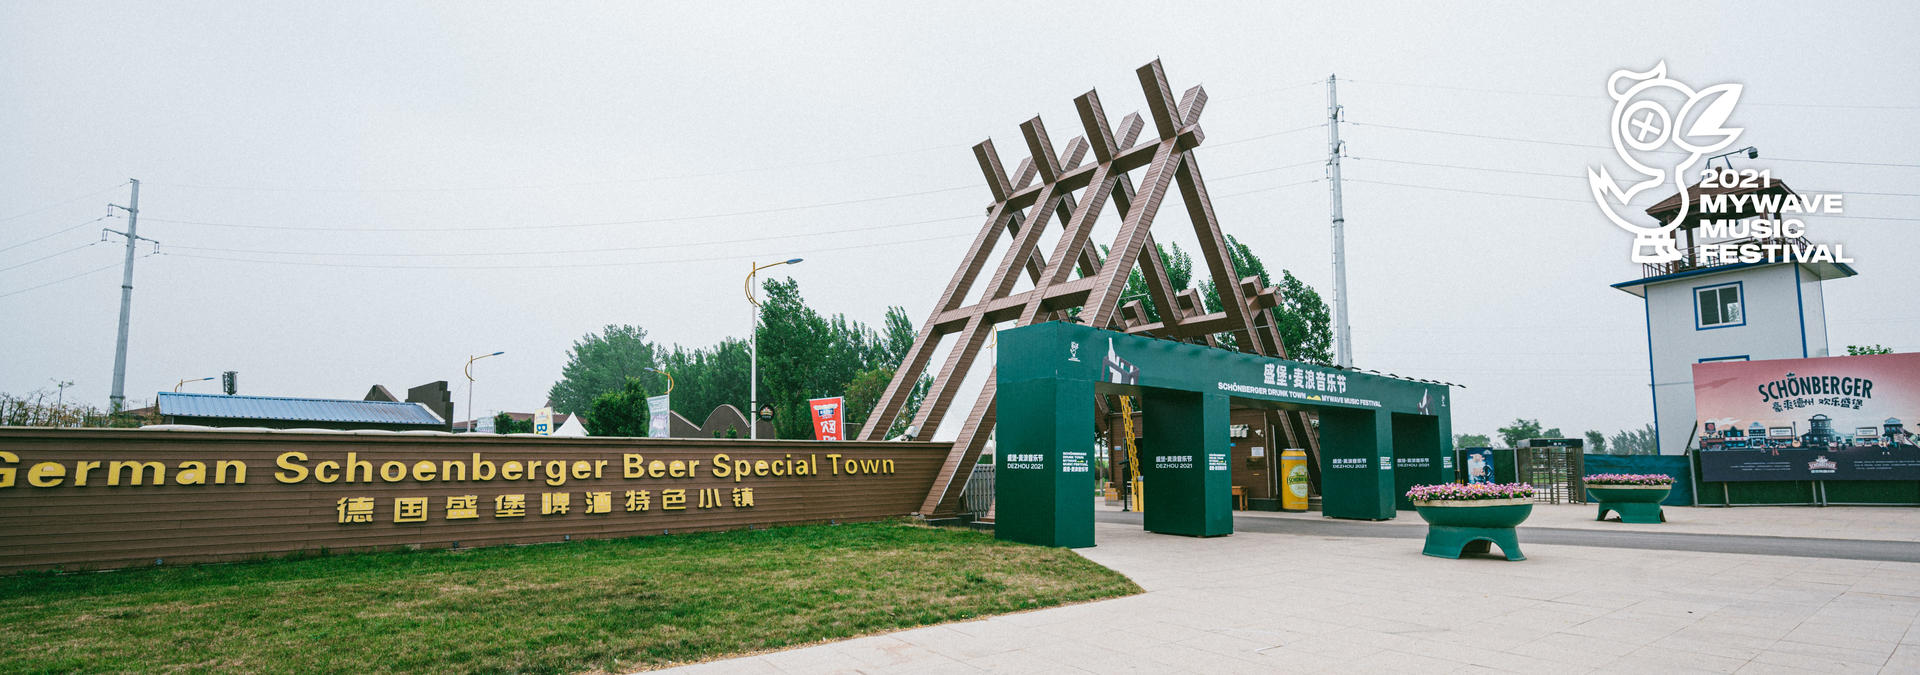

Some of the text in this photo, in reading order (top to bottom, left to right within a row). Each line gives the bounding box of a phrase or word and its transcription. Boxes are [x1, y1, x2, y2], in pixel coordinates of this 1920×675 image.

[1288, 391, 1307, 400] TOWN
[274, 451, 607, 487] Schoenberger
[623, 453, 700, 480] Beer
[712, 453, 818, 482] Special
[826, 454, 896, 475] Town
[336, 487, 755, 524] 德国盛堡啤酒特色小镇
